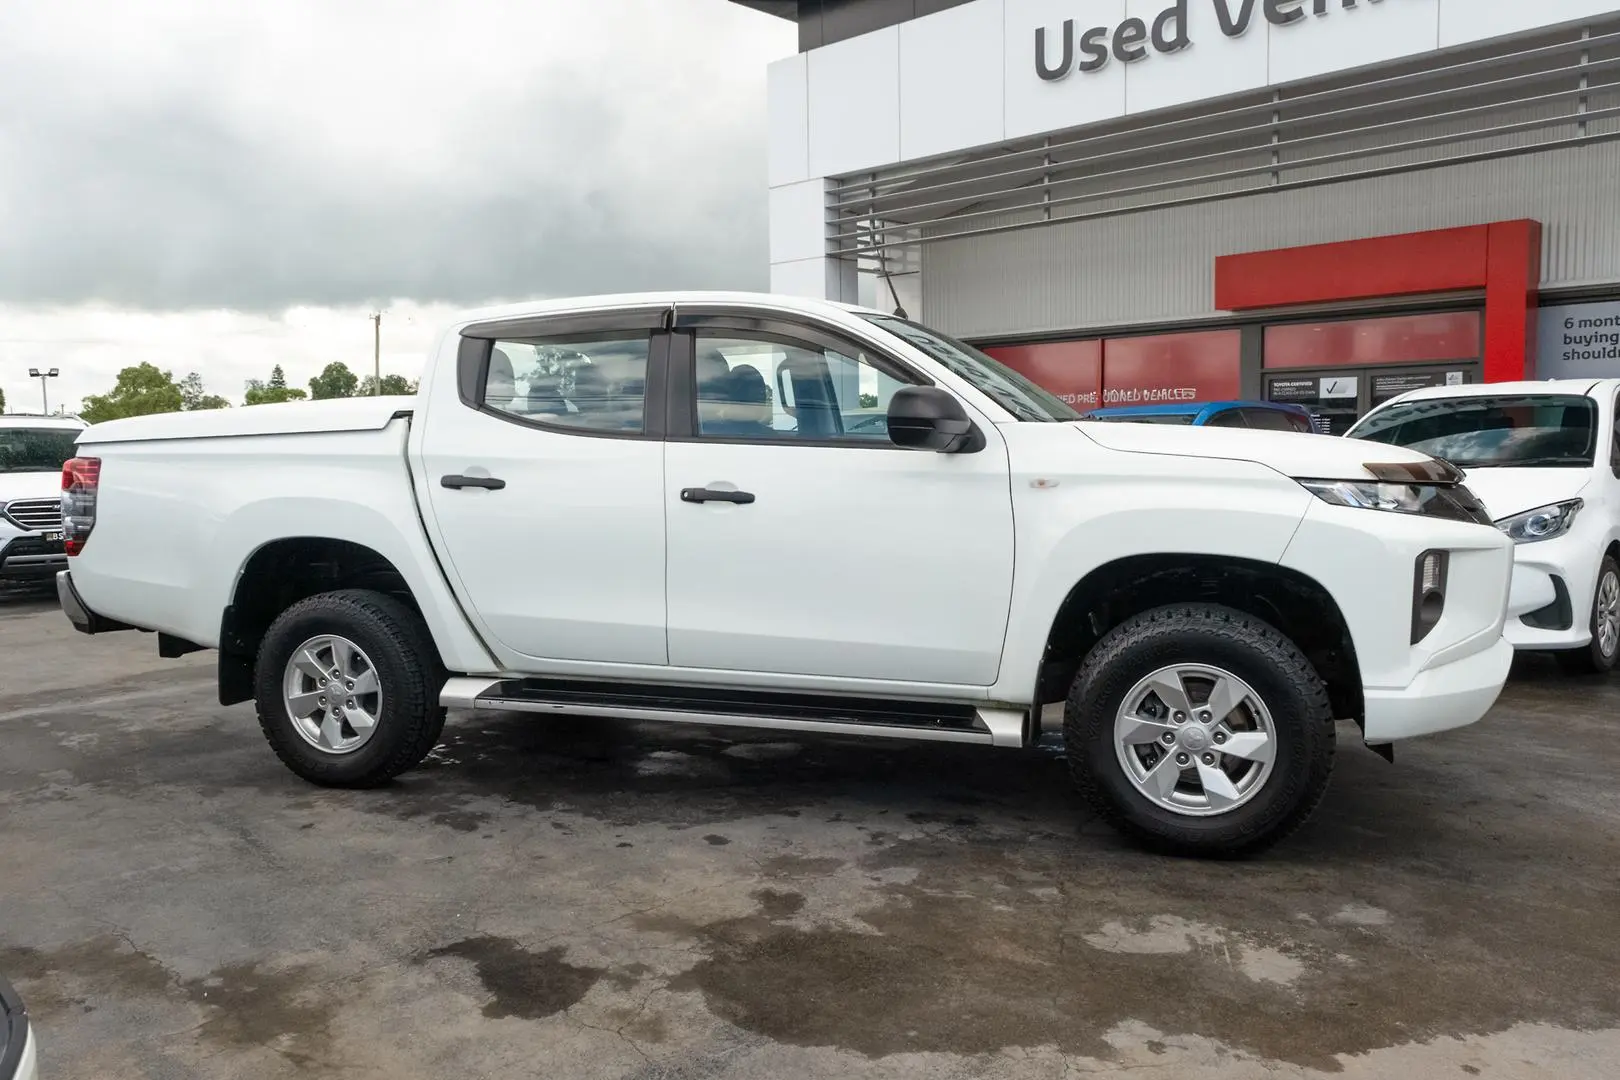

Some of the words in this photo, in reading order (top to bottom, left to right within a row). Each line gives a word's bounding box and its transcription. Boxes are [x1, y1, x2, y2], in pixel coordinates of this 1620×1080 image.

[1034, 0, 1192, 81] Used
[1564, 317, 1574, 329] 6
[1563, 331, 1619, 347] buying
[1562, 346, 1620, 361] should
